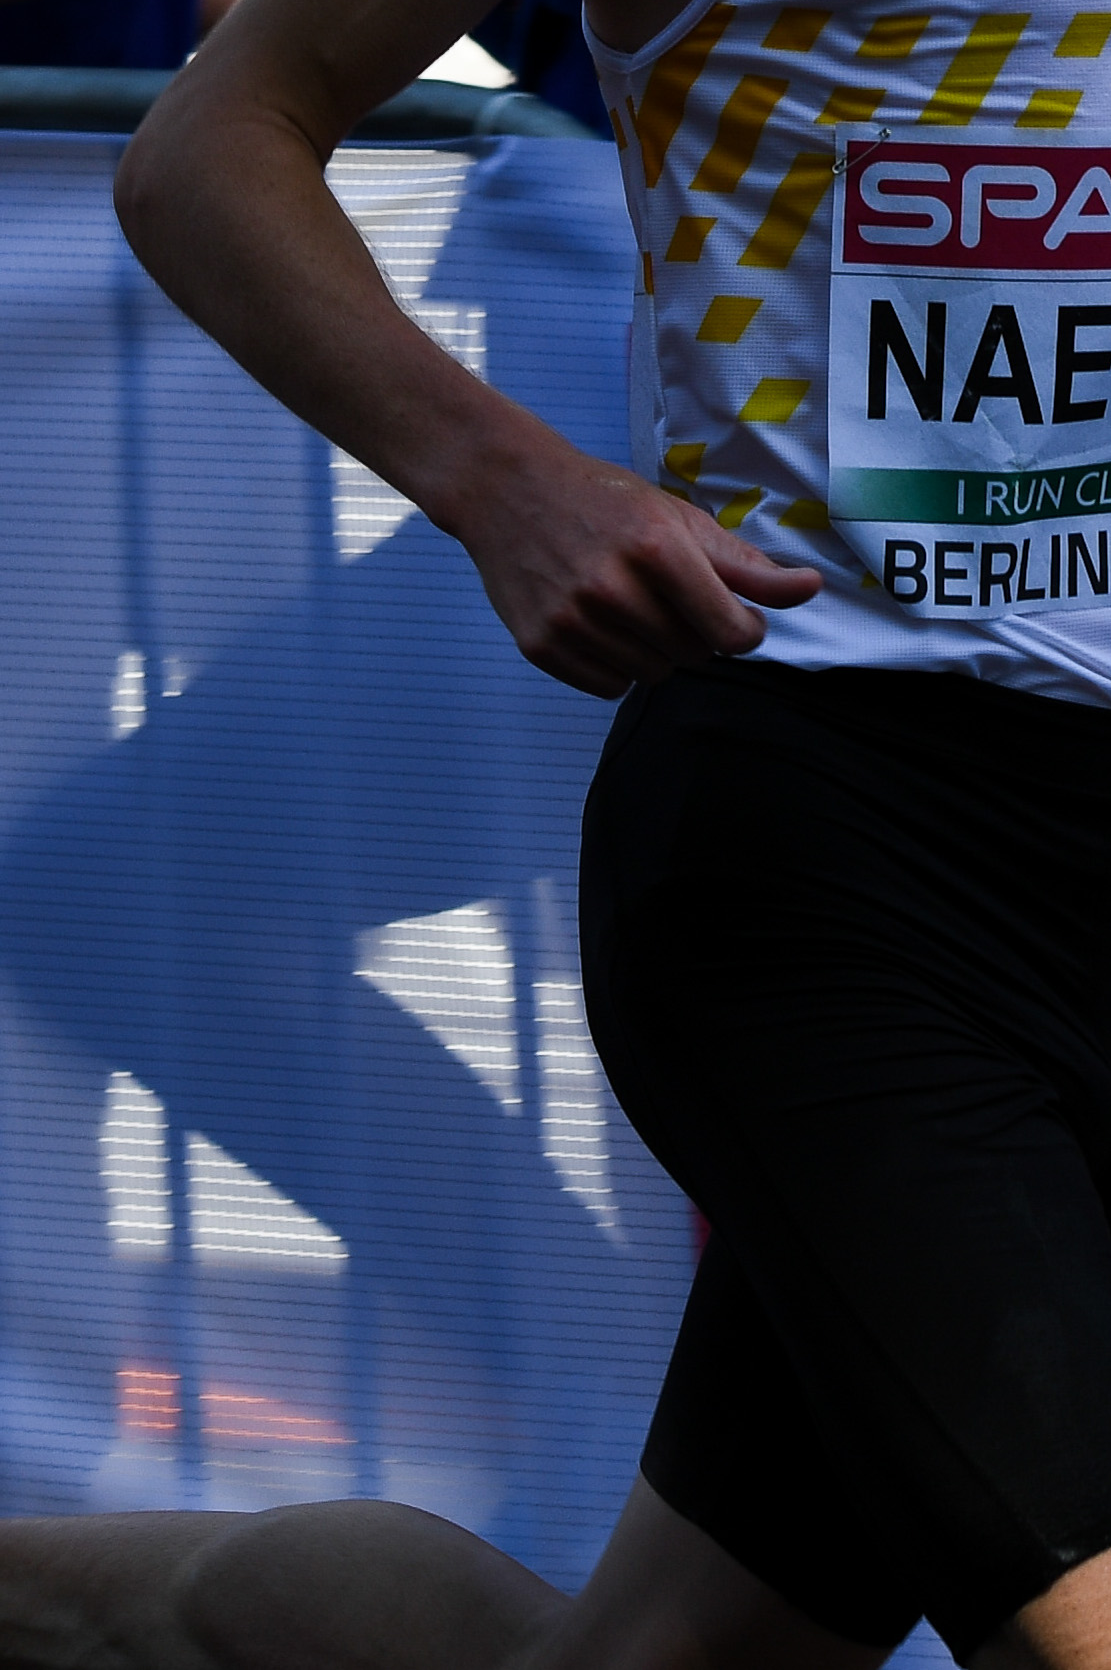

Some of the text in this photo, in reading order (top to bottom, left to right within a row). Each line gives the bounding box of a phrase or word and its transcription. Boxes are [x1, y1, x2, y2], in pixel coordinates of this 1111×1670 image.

[957, 478, 966, 516] I
[986, 477, 1066, 516] RUN
[884, 532, 1110, 607] BERLIN
